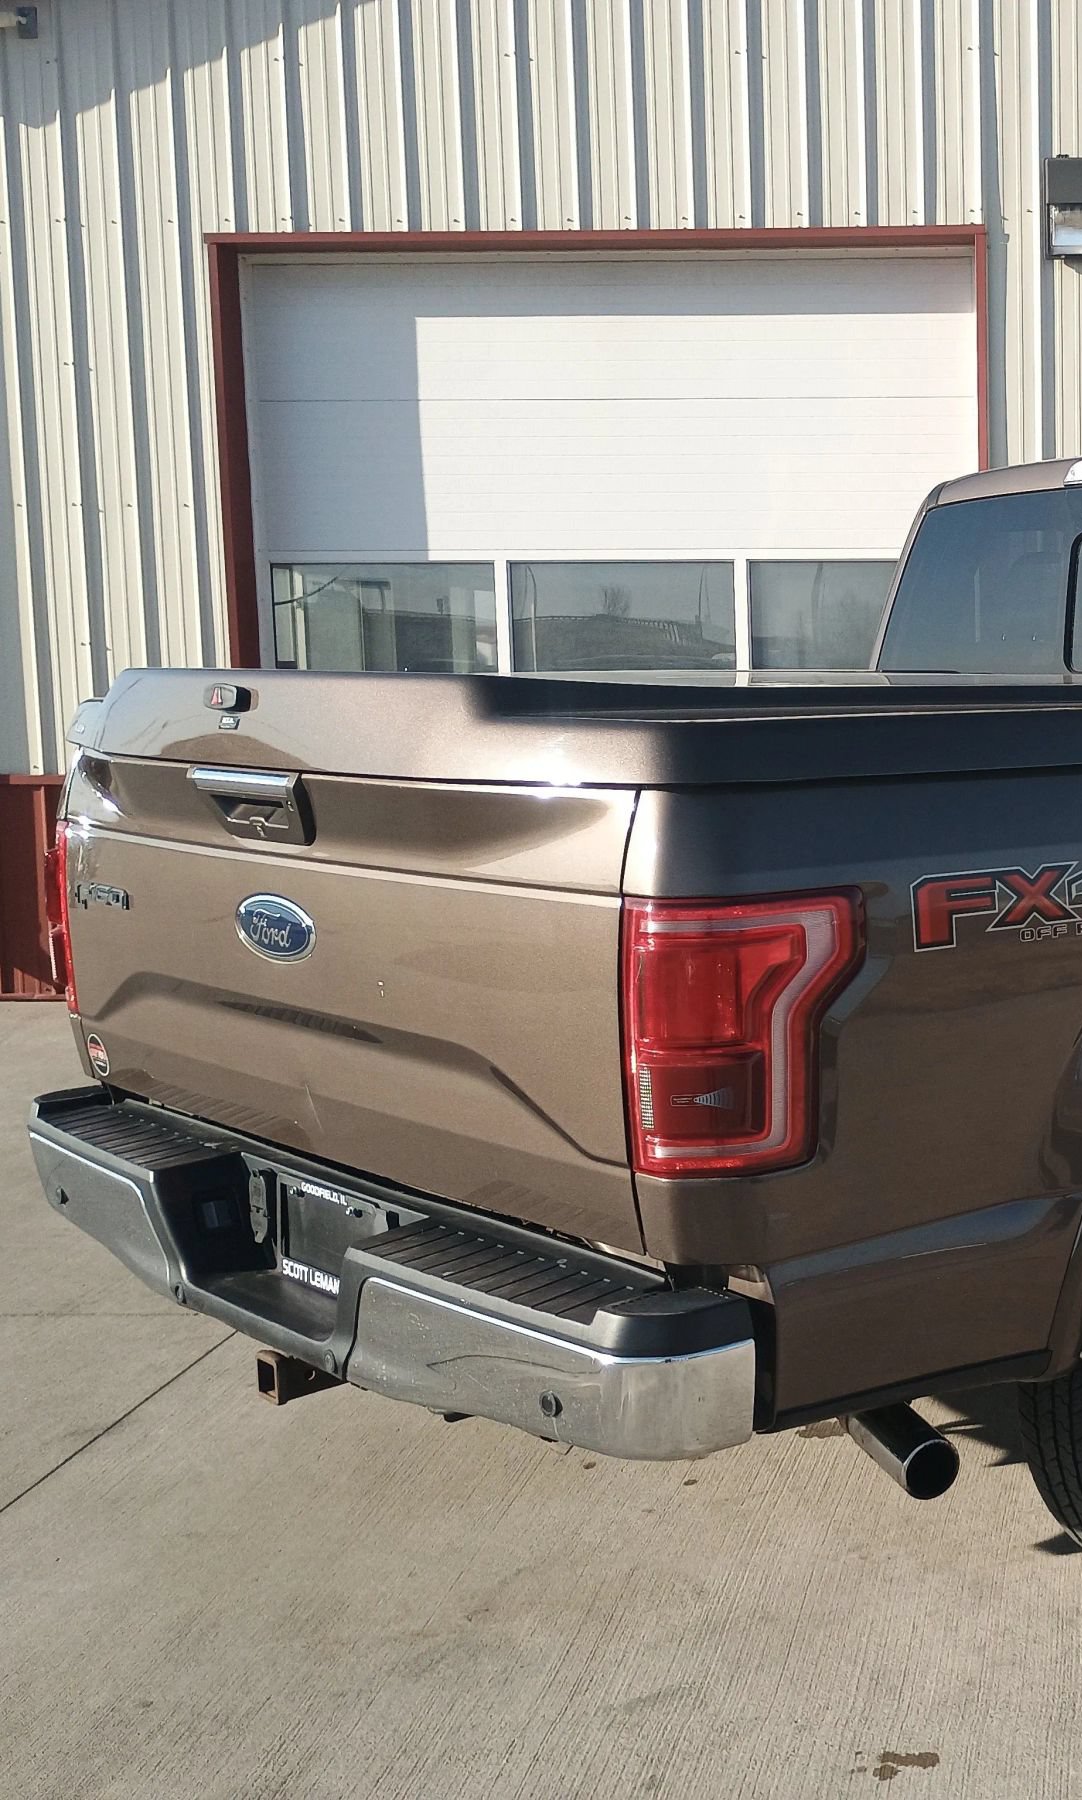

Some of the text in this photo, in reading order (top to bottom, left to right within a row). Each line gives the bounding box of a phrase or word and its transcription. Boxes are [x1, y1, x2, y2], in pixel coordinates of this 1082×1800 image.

[250, 908, 292, 948] Ford
[1019, 924, 1068, 942] OFF
[340, 1194, 348, 1206] IL
[282, 1259, 340, 1295] SCOTT LEMAN
